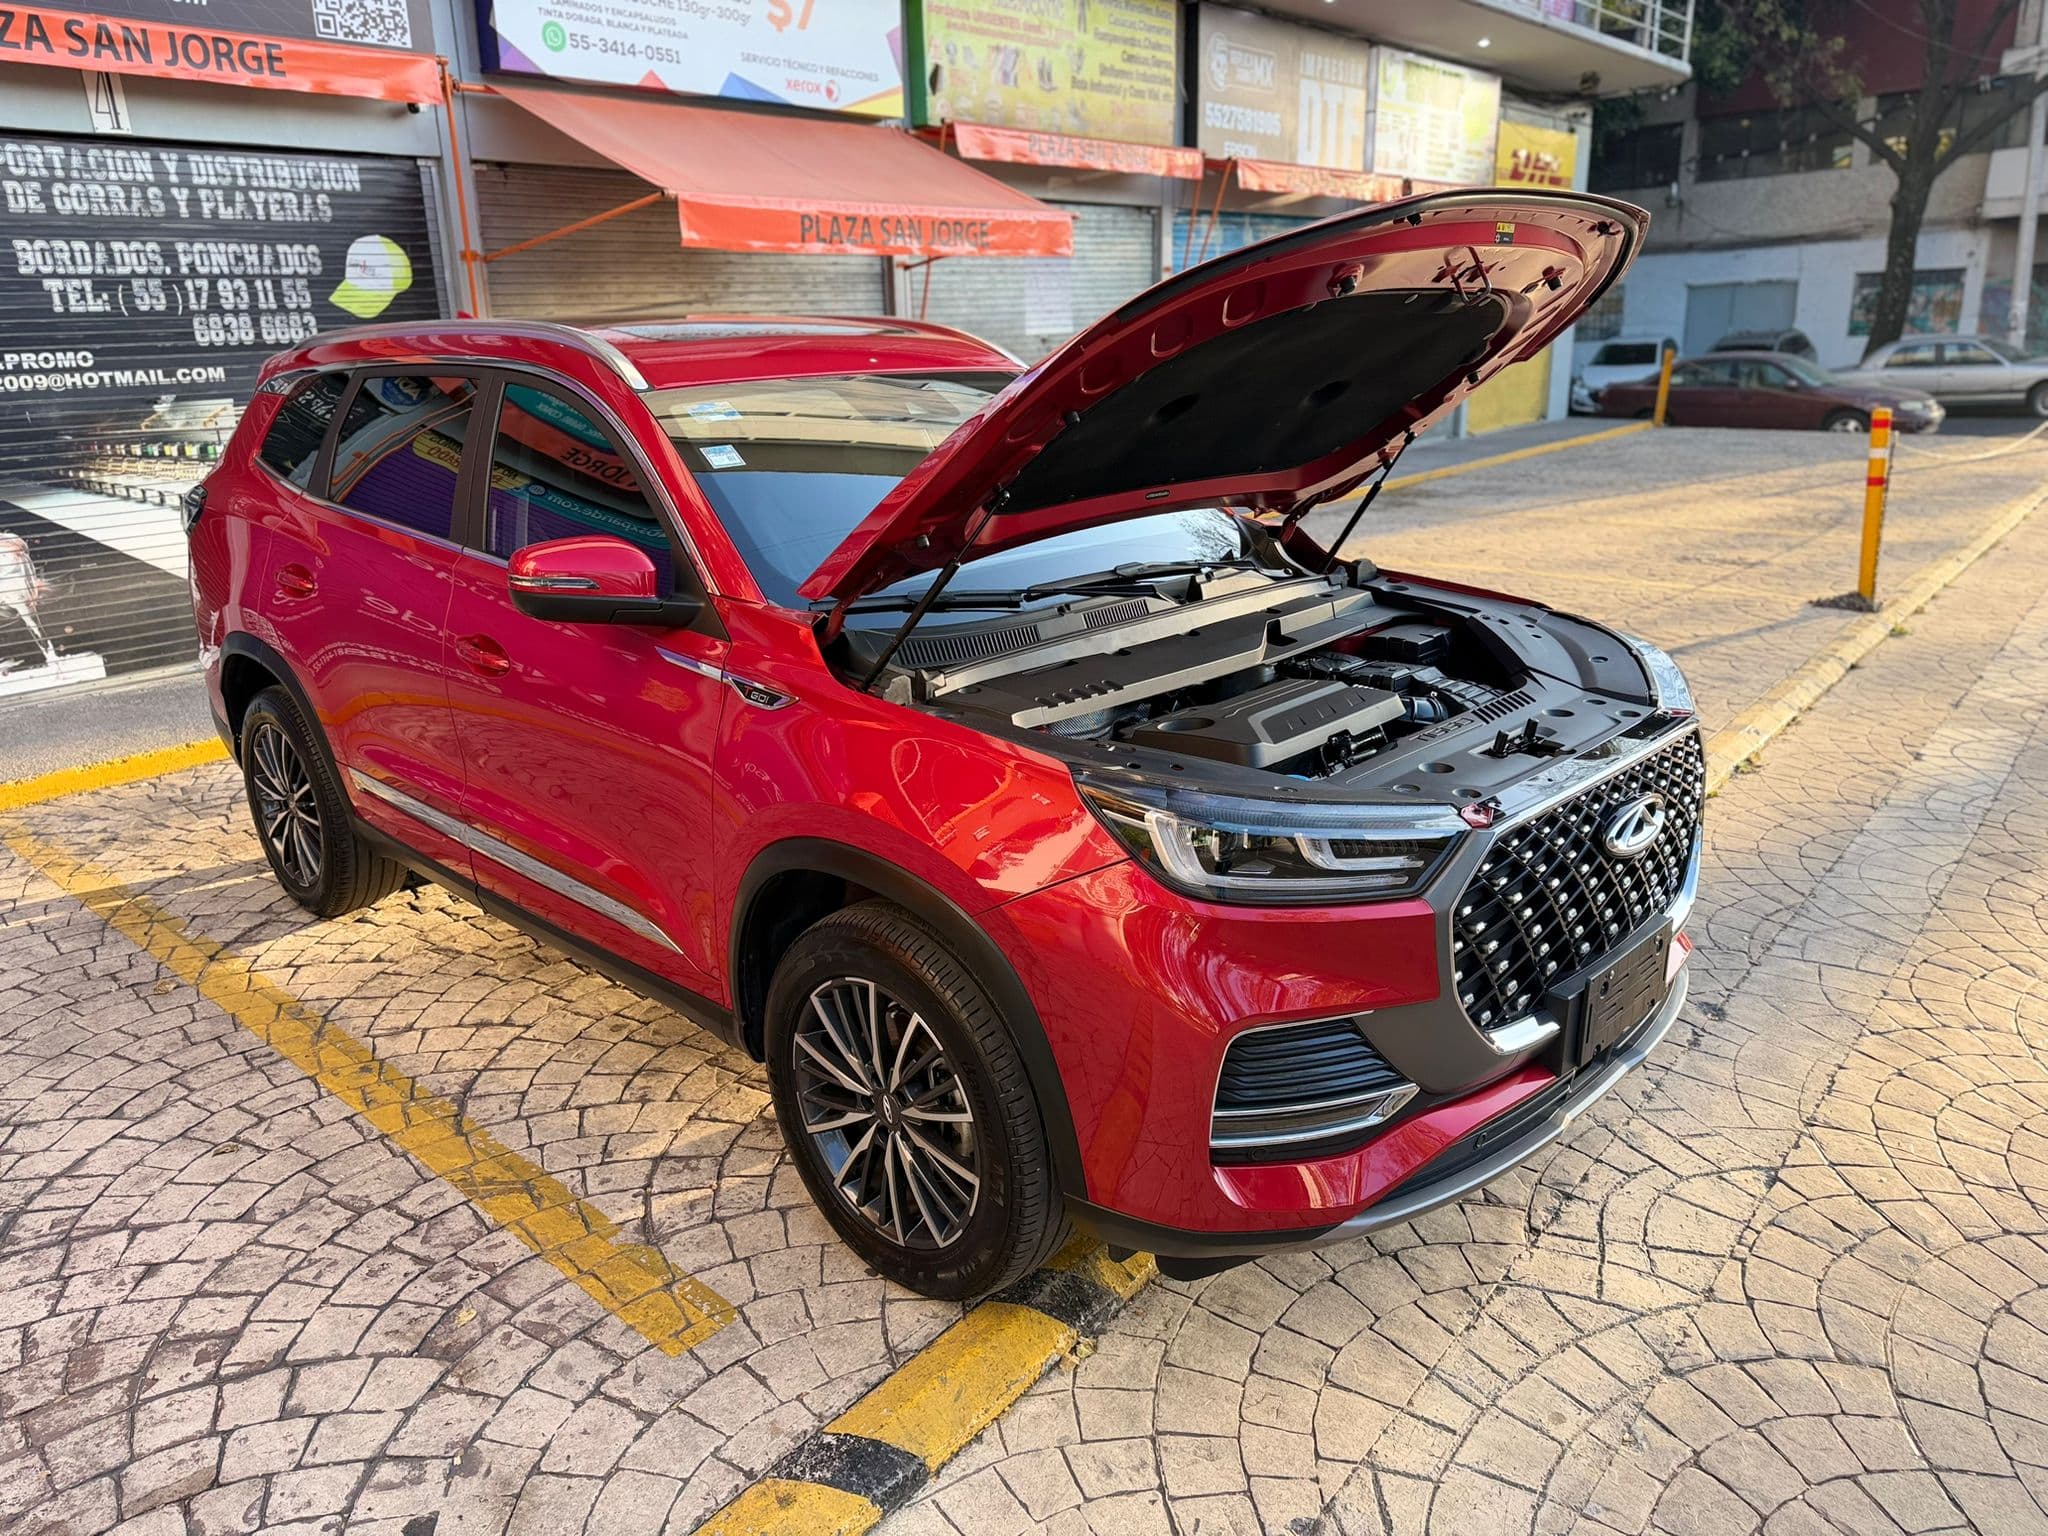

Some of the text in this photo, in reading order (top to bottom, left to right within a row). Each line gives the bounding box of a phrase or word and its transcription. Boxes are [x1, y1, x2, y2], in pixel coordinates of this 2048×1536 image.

[537, 7, 565, 18] TINTA
[606, 18, 640, 31] BLANCA
[647, 25, 688, 39] PLATEADA
[64, 20, 152, 64] SAN
[164, 31, 287, 78] JORGE
[569, 32, 682, 64] 55-3414-0551
[741, 52, 781, 67] SERVICIO
[825, 66, 879, 82] REFACCIONES
[785, 78, 822, 94] xerox
[0, 144, 361, 192] ORTACION Y DISTRIBUCION
[2, 180, 333, 223] DE GORRAS Y PLAYERAS
[800, 213, 990, 248] PLAZA SAN JORGE
[174, 242, 323, 275] PONCHADOS
[42, 279, 111, 312] TEL:
[184, 279, 209, 310] 17
[217, 278, 250, 310] 93
[254, 279, 278, 310] 11
[281, 278, 312, 310] 55
[192, 312, 255, 347] 6838
[0, 351, 94, 370] PROMO
